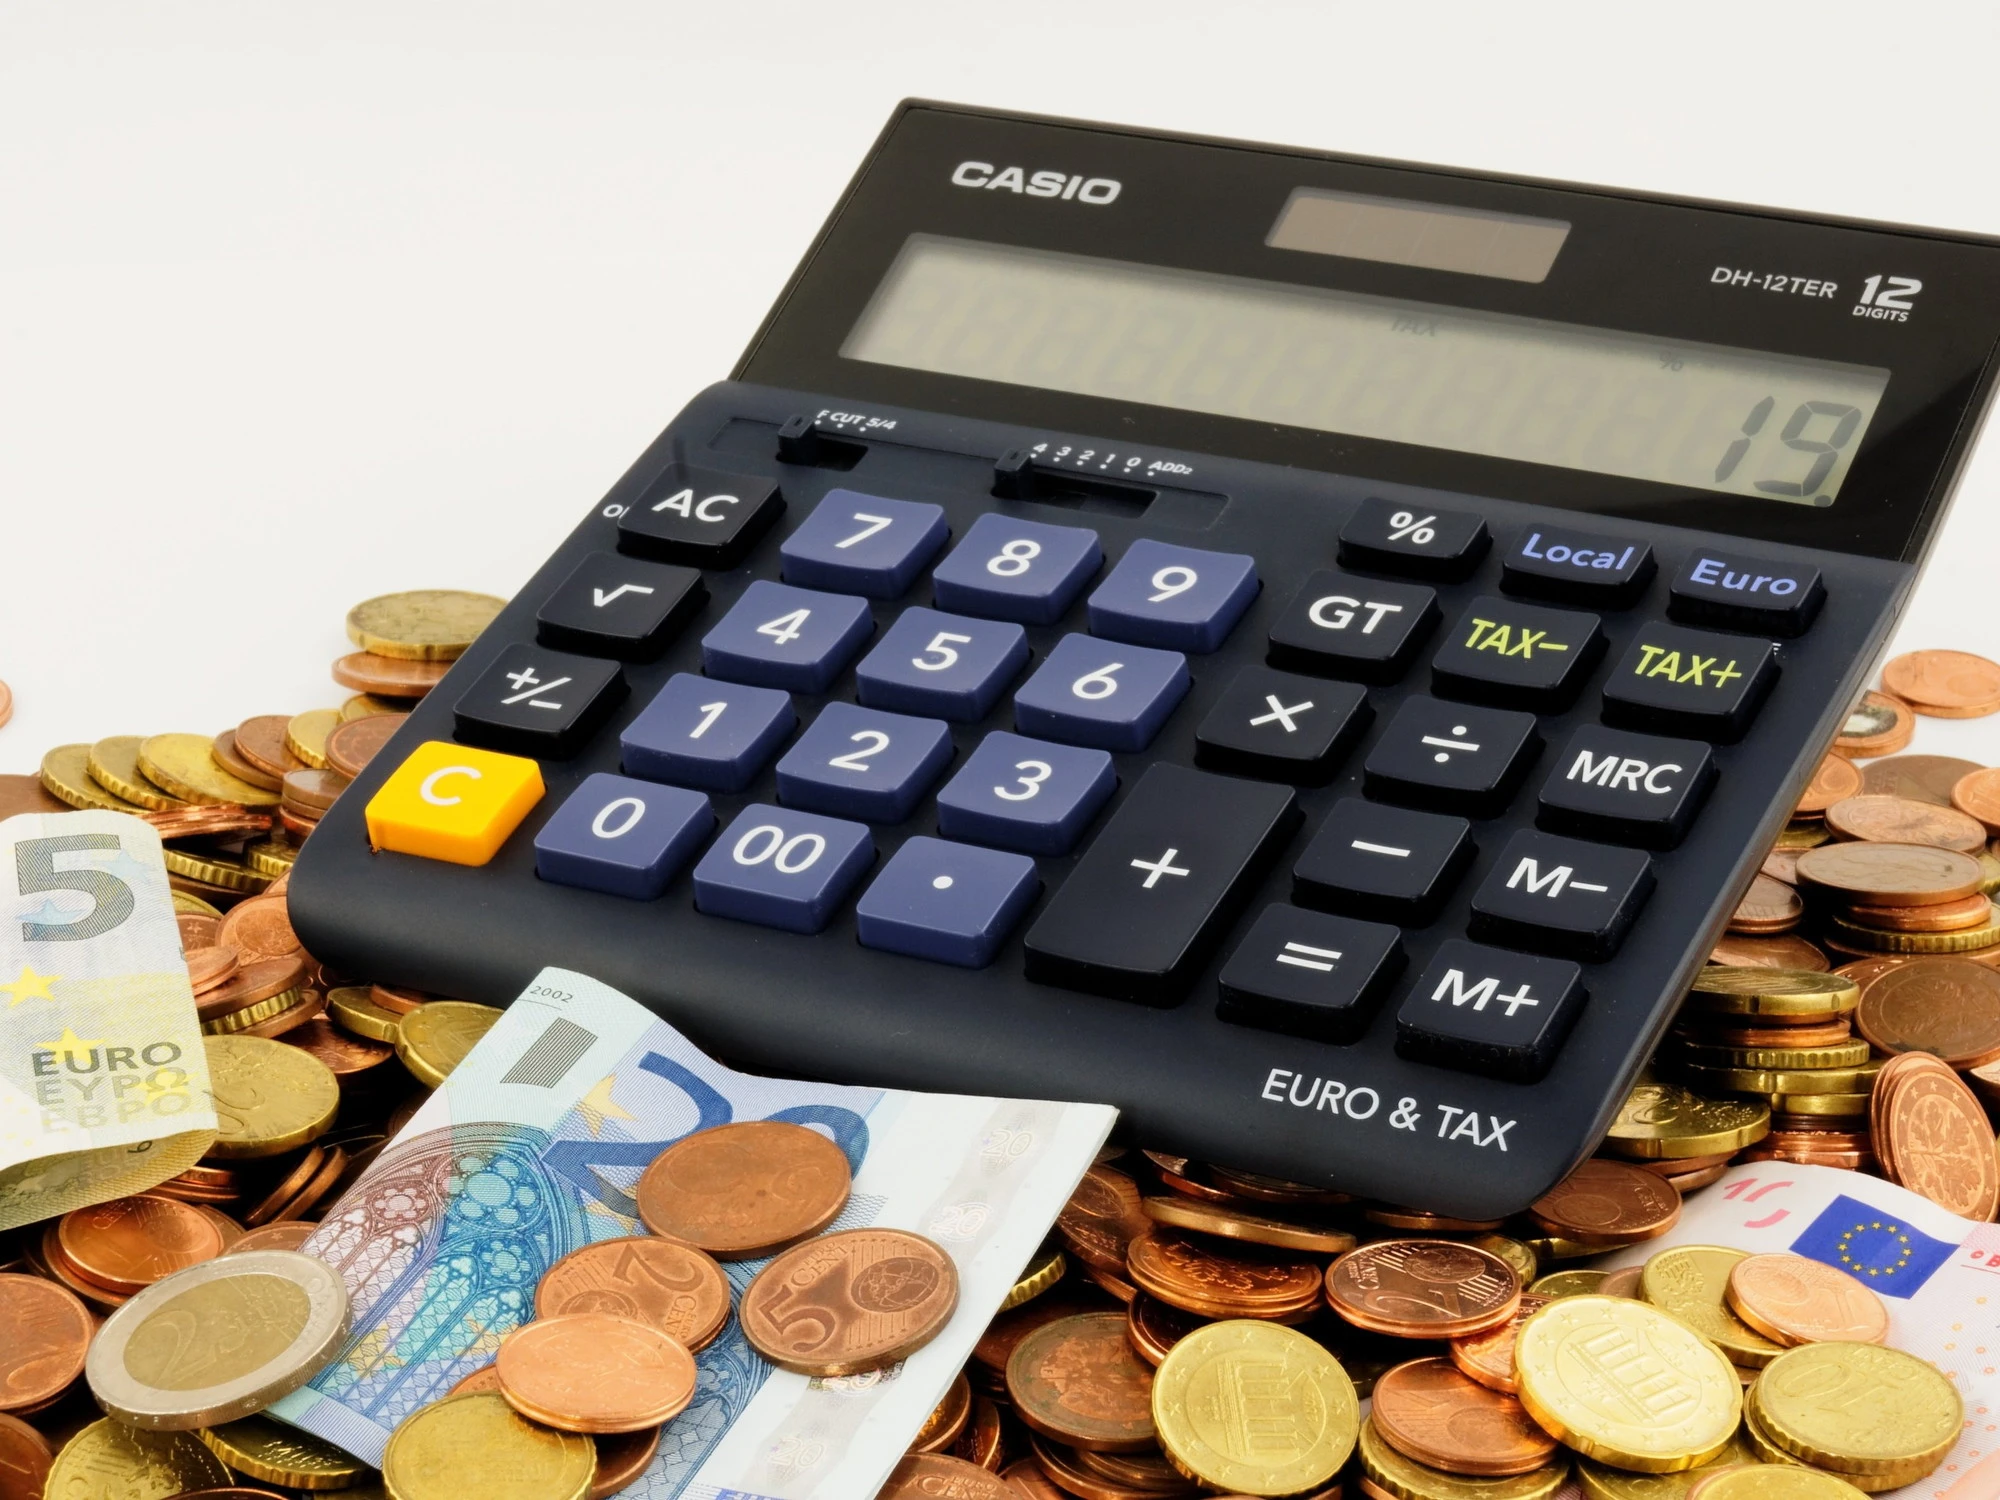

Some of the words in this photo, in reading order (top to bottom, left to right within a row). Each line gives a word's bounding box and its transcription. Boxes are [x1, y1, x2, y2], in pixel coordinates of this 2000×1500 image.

[952, 161, 1122, 205] CASIO
[1710, 266, 1838, 299] DH-12TER
[1859, 275, 1923, 310] 12
[1851, 305, 1910, 323] DIGITS
[816, 410, 830, 420] F
[830, 412, 865, 426] CUT
[865, 417, 898, 431] 5/4
[1032, 442, 1049, 454] 4
[1055, 446, 1073, 457] 3
[1078, 449, 1096, 461] 2
[1105, 453, 1117, 465] 1
[1125, 457, 1143, 468] 0
[651, 488, 740, 522] AC
[835, 512, 893, 549] 7
[1388, 511, 1437, 544] %
[986, 539, 1041, 577] 8
[1521, 532, 1635, 571] Local
[1147, 566, 1199, 603] 9
[1689, 558, 1798, 596] Euro
[756, 608, 811, 645] 4
[1308, 595, 1403, 634] GT
[912, 631, 972, 671] 5
[1633, 644, 1743, 689] TAX+
[1071, 662, 1124, 700] 6
[689, 701, 728, 739] 1
[828, 730, 890, 772] 2
[420, 766, 482, 806] C
[993, 760, 1053, 801] 3
[1566, 750, 1683, 794] MRC
[591, 797, 646, 839] 0
[732, 825, 826, 874] 00
[15, 833, 136, 942] 5
[529, 984, 574, 1003] 2002
[1431, 968, 1539, 1017] M+
[31, 1041, 182, 1077] EURO
[1261, 1068, 1380, 1120] EURO
[1388, 1096, 1420, 1132] &
[1437, 1104, 1517, 1152] TAX
[613, 1243, 705, 1292] 2
[791, 1244, 849, 1288] CENT
[663, 1294, 698, 1337] CENT
[758, 1283, 838, 1354] 5
